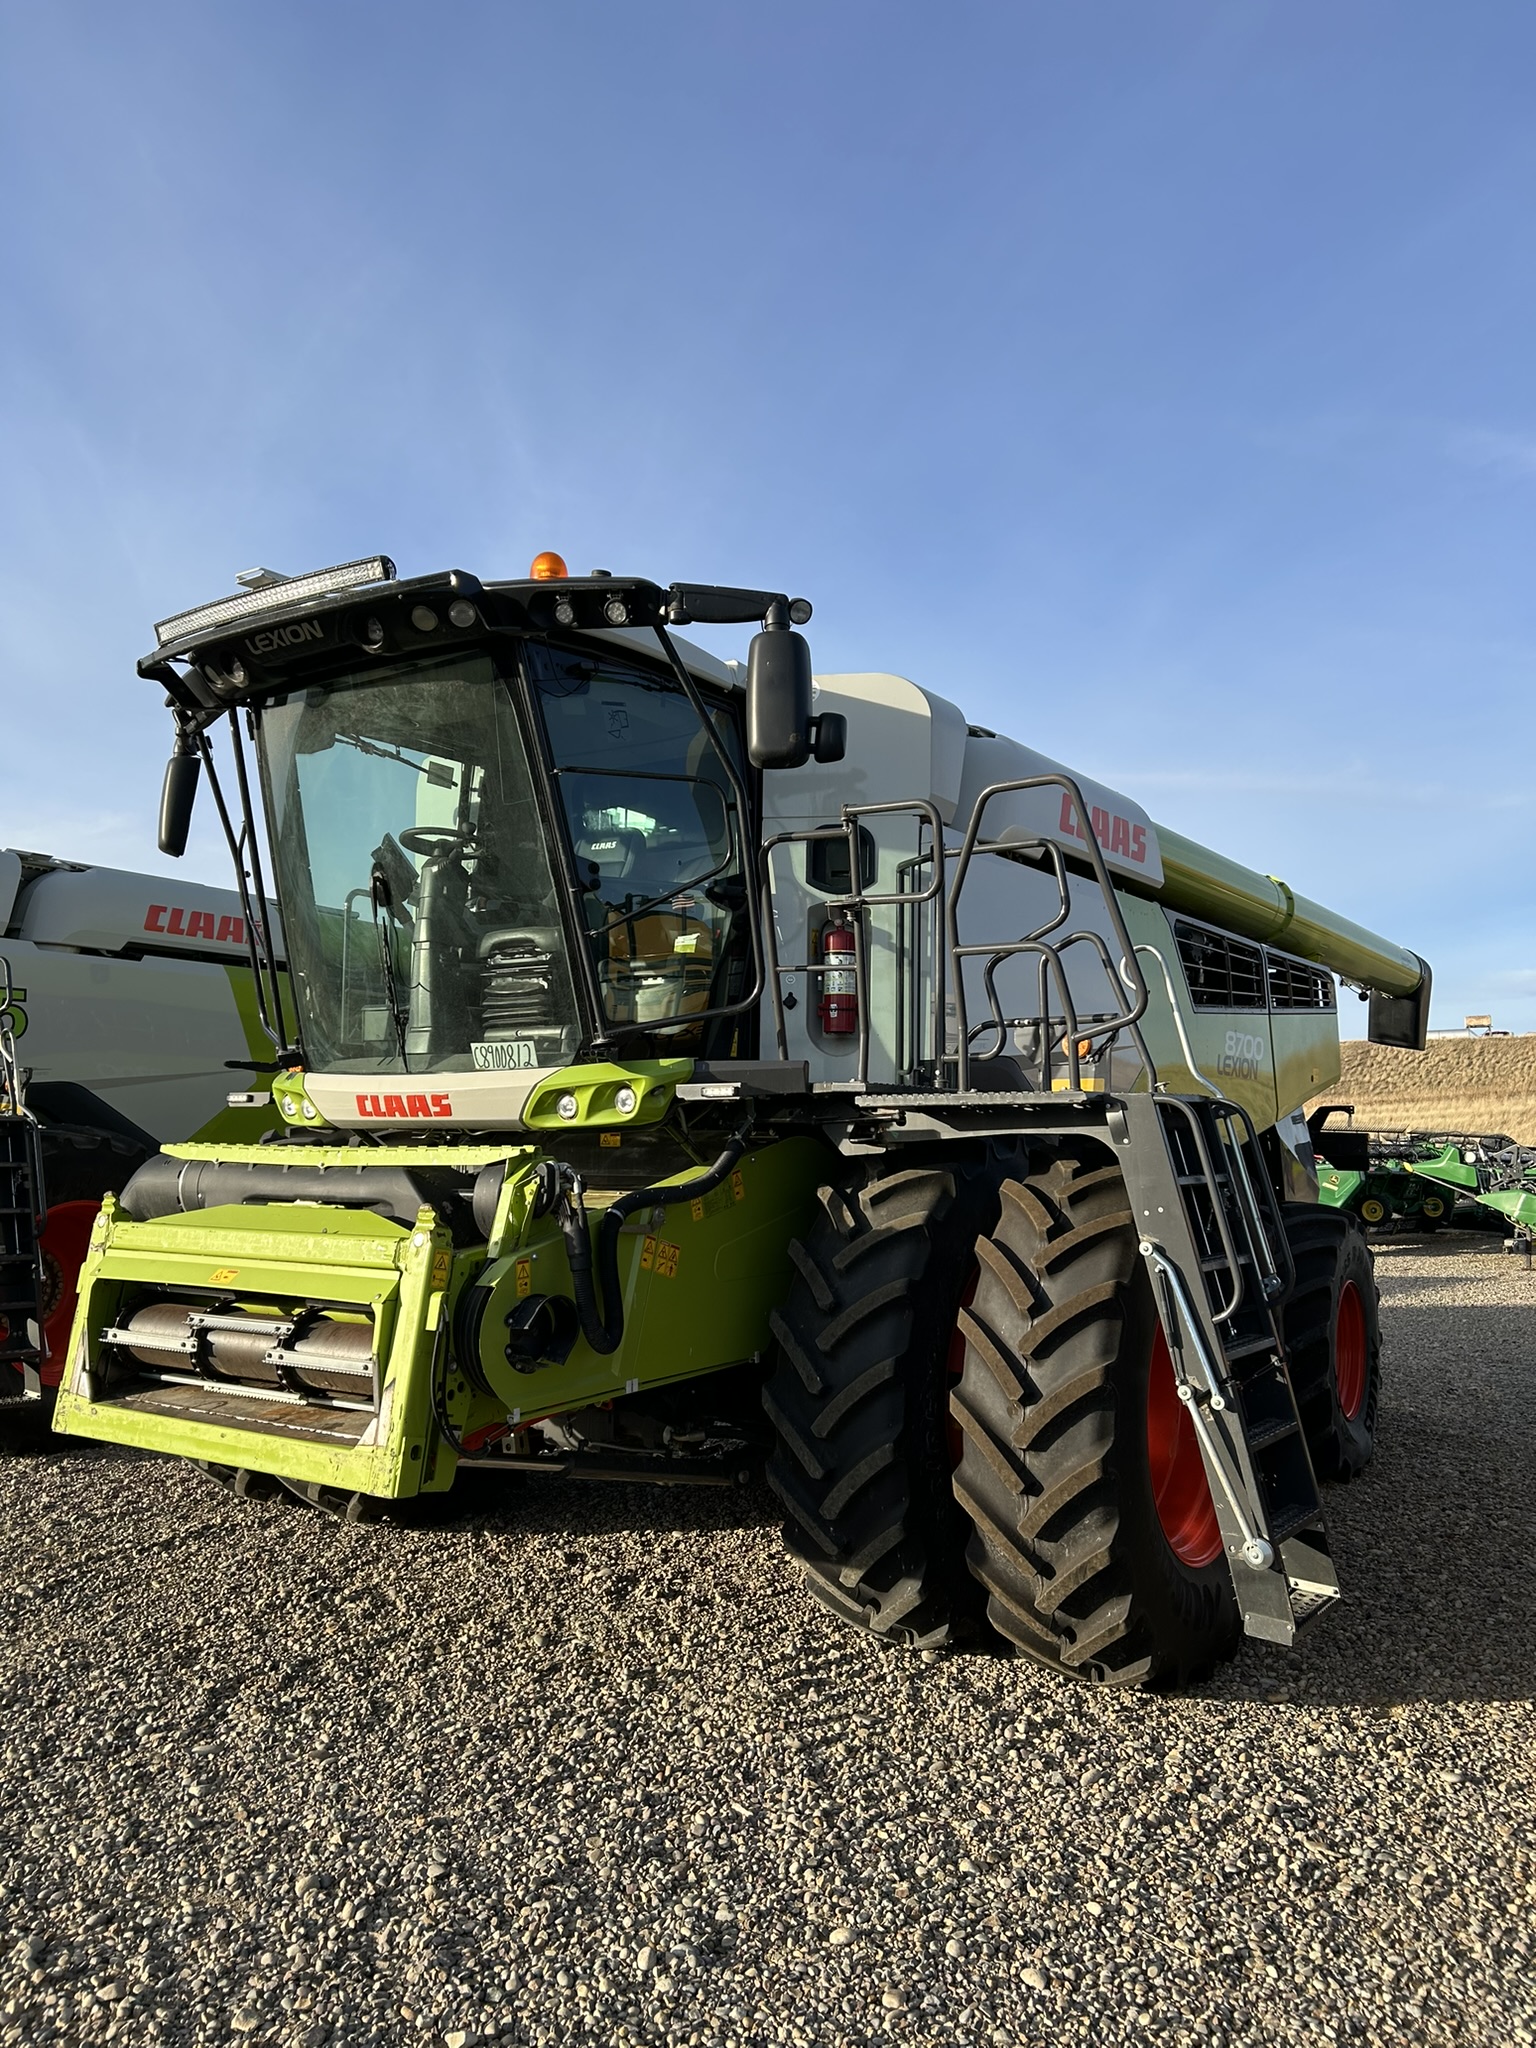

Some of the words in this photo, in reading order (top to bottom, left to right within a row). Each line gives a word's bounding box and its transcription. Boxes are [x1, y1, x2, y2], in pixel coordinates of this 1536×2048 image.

[244, 620, 324, 655] LEXION
[591, 841, 617, 850] CLAAS
[474, 1043, 534, 1069] C8900812
[1225, 1030, 1264, 1060] 8700
[1217, 1054, 1259, 1080] LEXION
[356, 1094, 452, 1117] CLAAS
